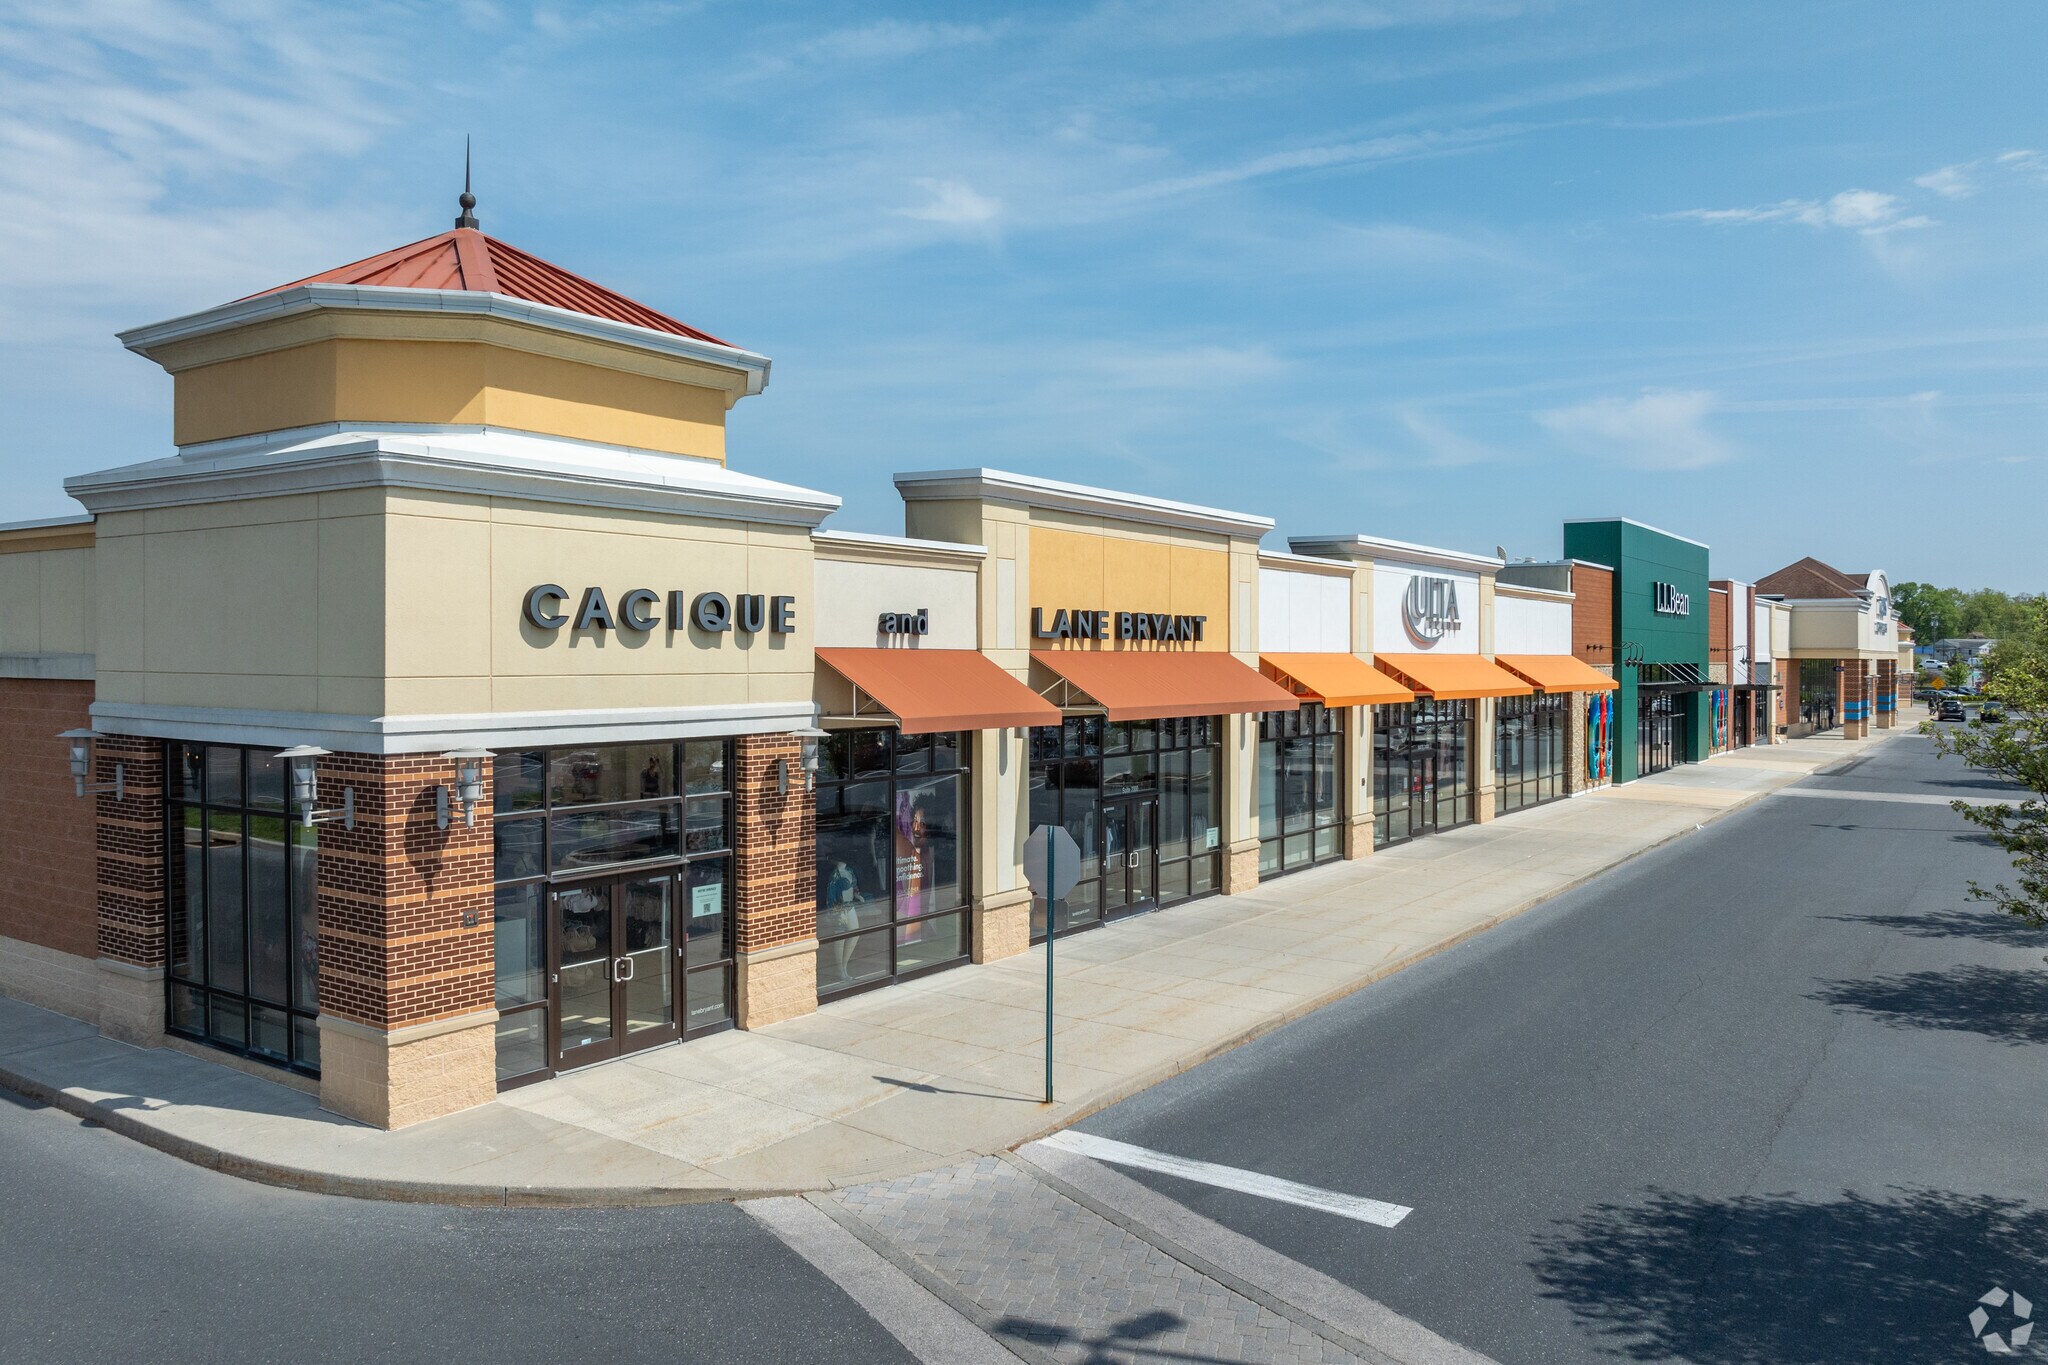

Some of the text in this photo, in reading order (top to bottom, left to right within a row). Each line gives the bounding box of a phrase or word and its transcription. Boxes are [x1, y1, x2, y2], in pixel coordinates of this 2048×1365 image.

[522, 583, 796, 633] CACIQUE
[1409, 575, 1460, 620] ULTA
[878, 608, 929, 636] and
[1031, 607, 1207, 642] LANE BRYANT
[896, 856, 919, 864] ltimate.
